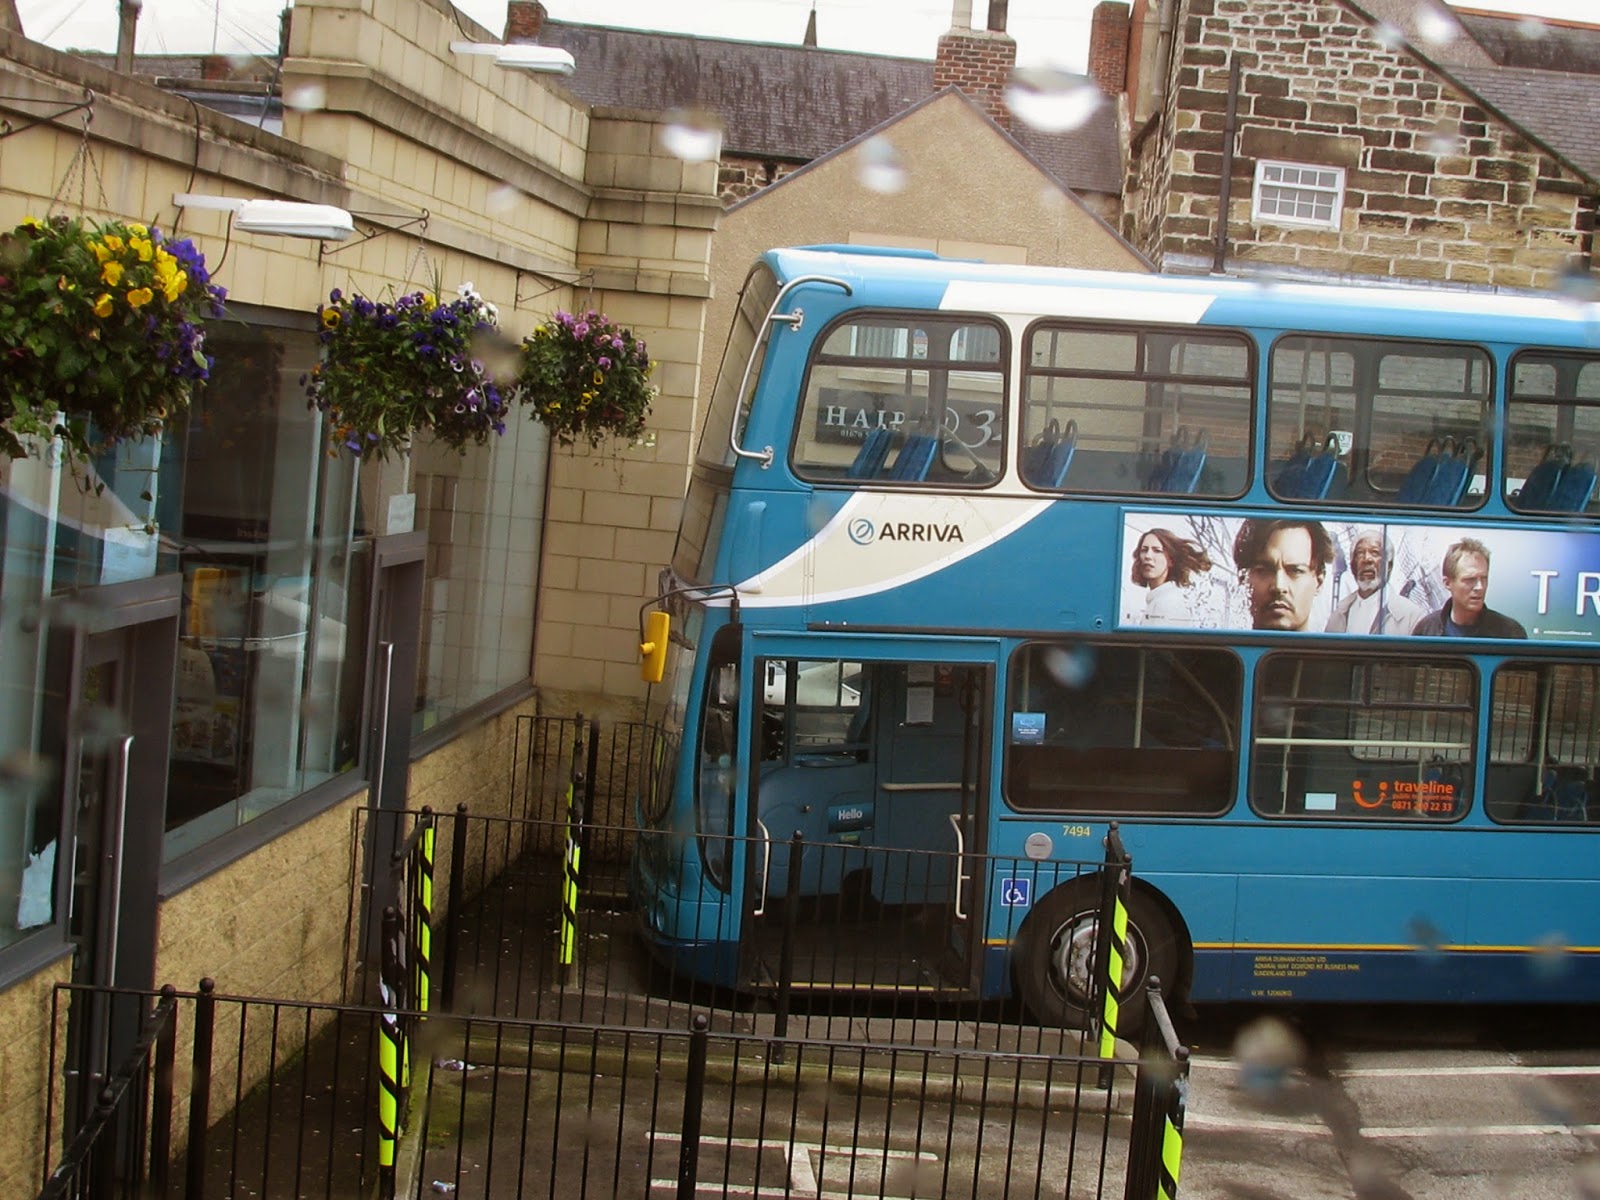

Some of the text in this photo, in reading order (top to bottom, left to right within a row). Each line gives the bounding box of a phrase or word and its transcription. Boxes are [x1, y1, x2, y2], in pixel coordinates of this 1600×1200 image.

[879, 522, 964, 543] ARRIVA
[1393, 780, 1454, 794] traveline
[838, 808, 864, 821] Hello
[1062, 825, 1091, 837] 7494
